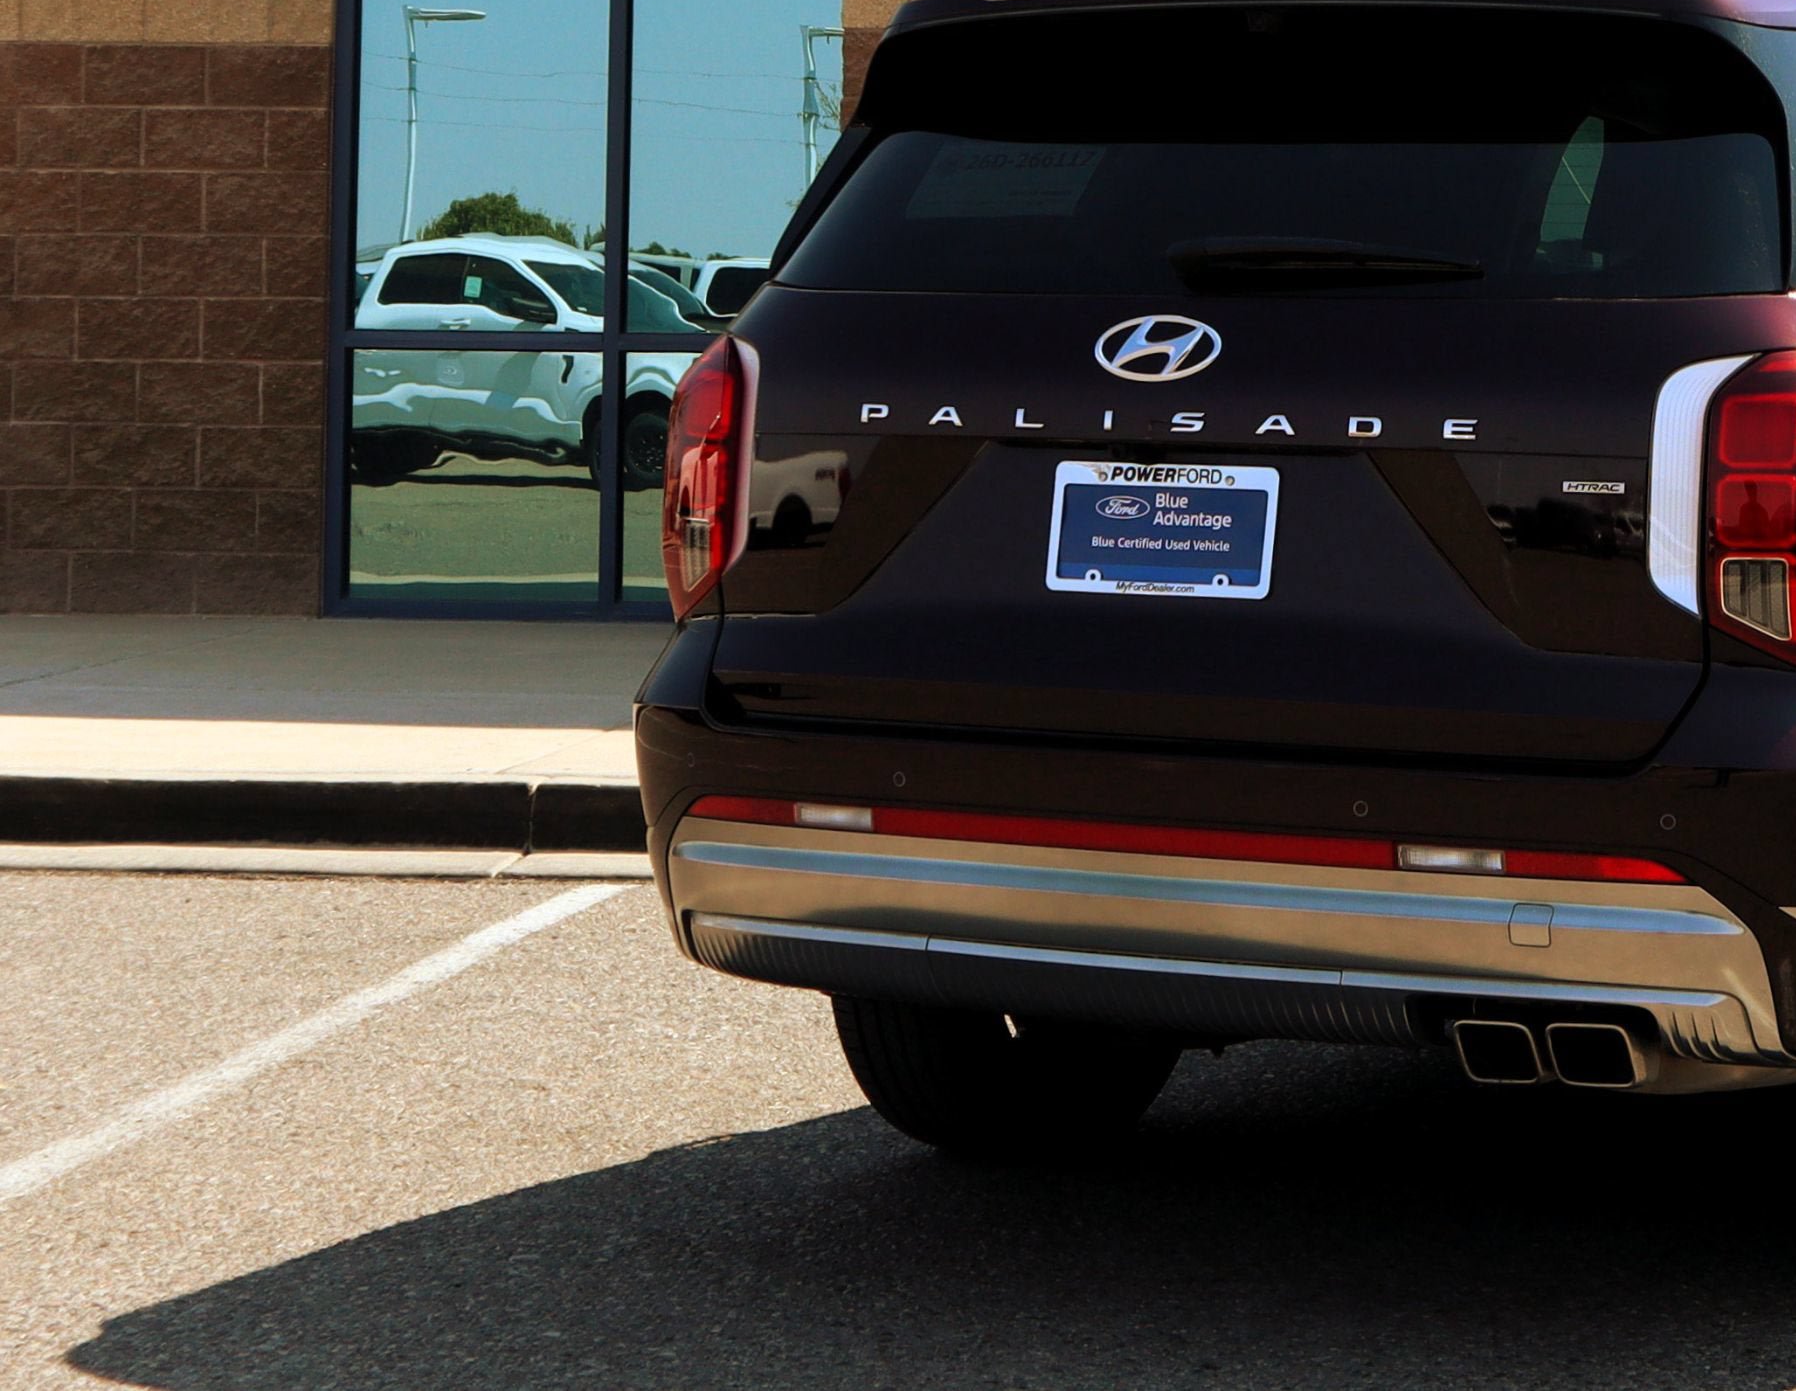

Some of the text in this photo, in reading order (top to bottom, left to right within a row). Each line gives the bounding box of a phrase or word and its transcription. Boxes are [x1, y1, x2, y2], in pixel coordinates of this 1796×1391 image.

[860, 403, 1478, 441] PALISADE
[1111, 466, 1222, 484] POWERFORD
[1567, 482, 1620, 492] HTRAC
[1105, 499, 1140, 516] Ford
[1155, 493, 1189, 508] Blue
[1153, 511, 1232, 529] Advantage
[1092, 536, 1230, 551] Blue Certified Used Vehicle
[1115, 581, 1195, 593] MyFordDealer.com
